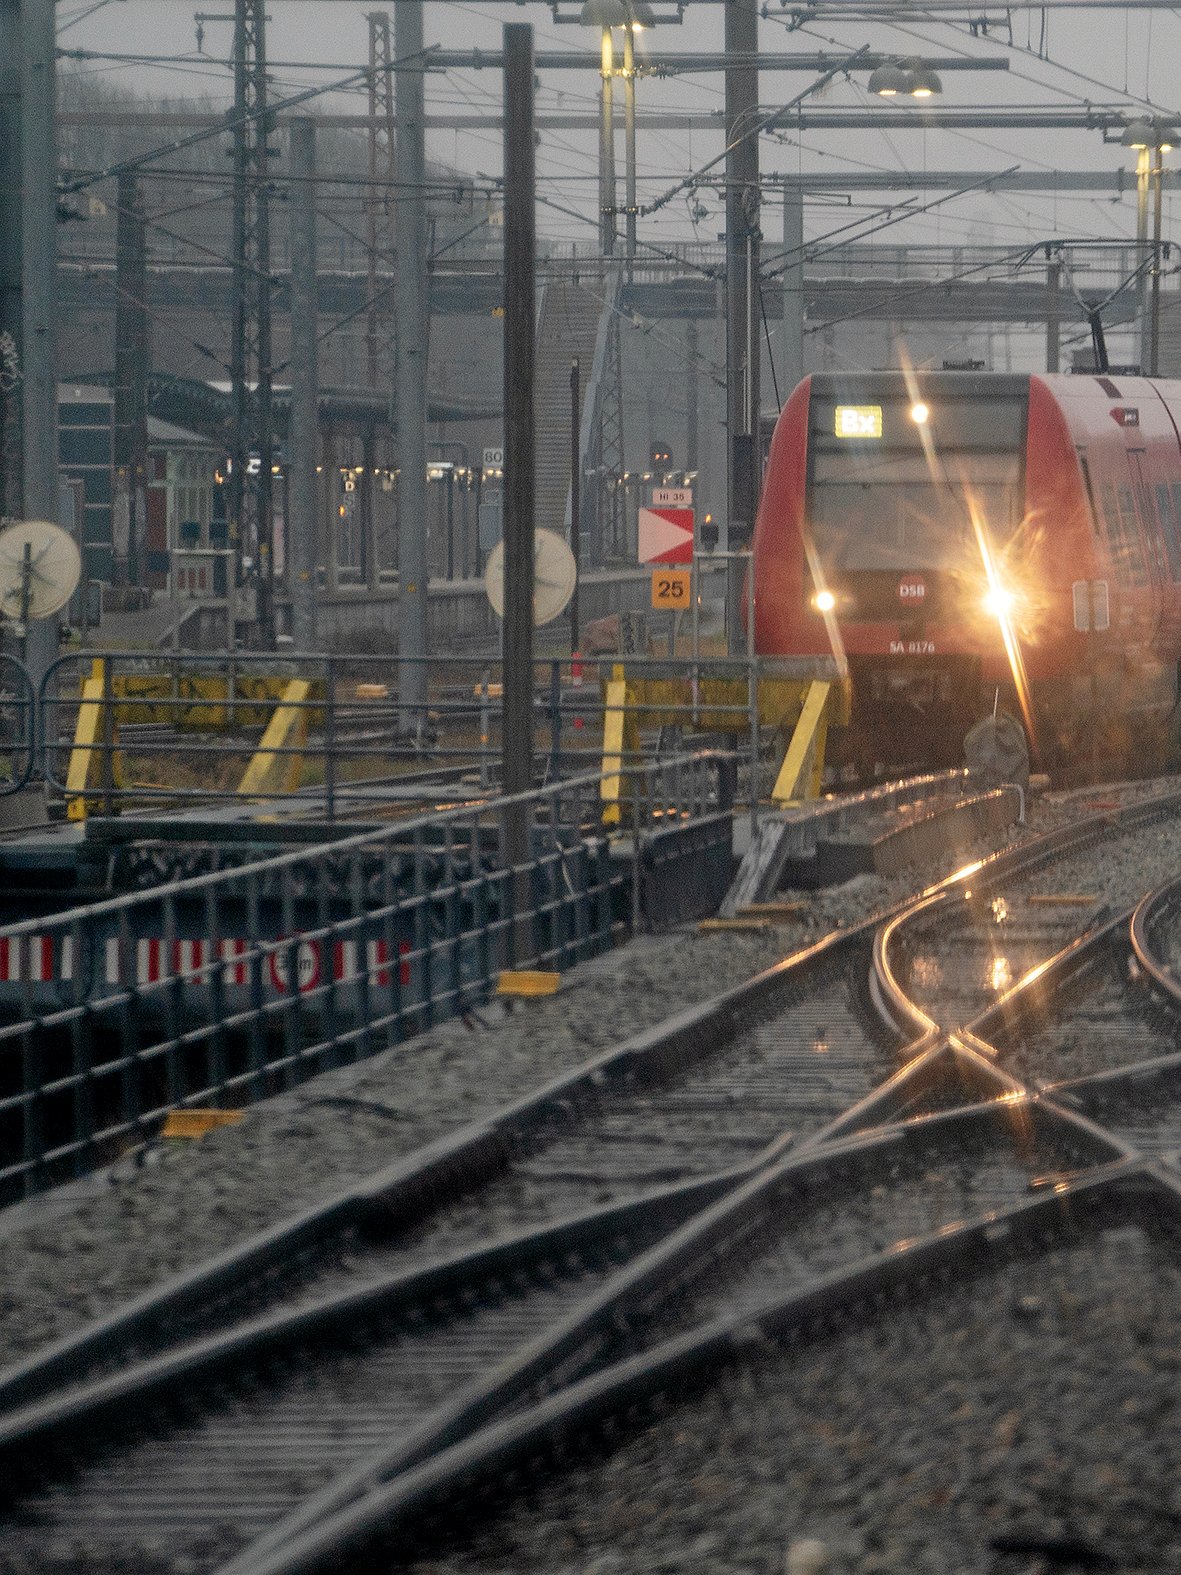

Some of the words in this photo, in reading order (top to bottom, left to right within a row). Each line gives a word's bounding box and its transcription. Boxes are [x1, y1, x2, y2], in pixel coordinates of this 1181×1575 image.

[842, 409, 875, 432] Bx
[485, 451, 502, 462] 80
[658, 580, 684, 598] 25
[900, 584, 925, 597] DSB
[890, 641, 905, 653] SA
